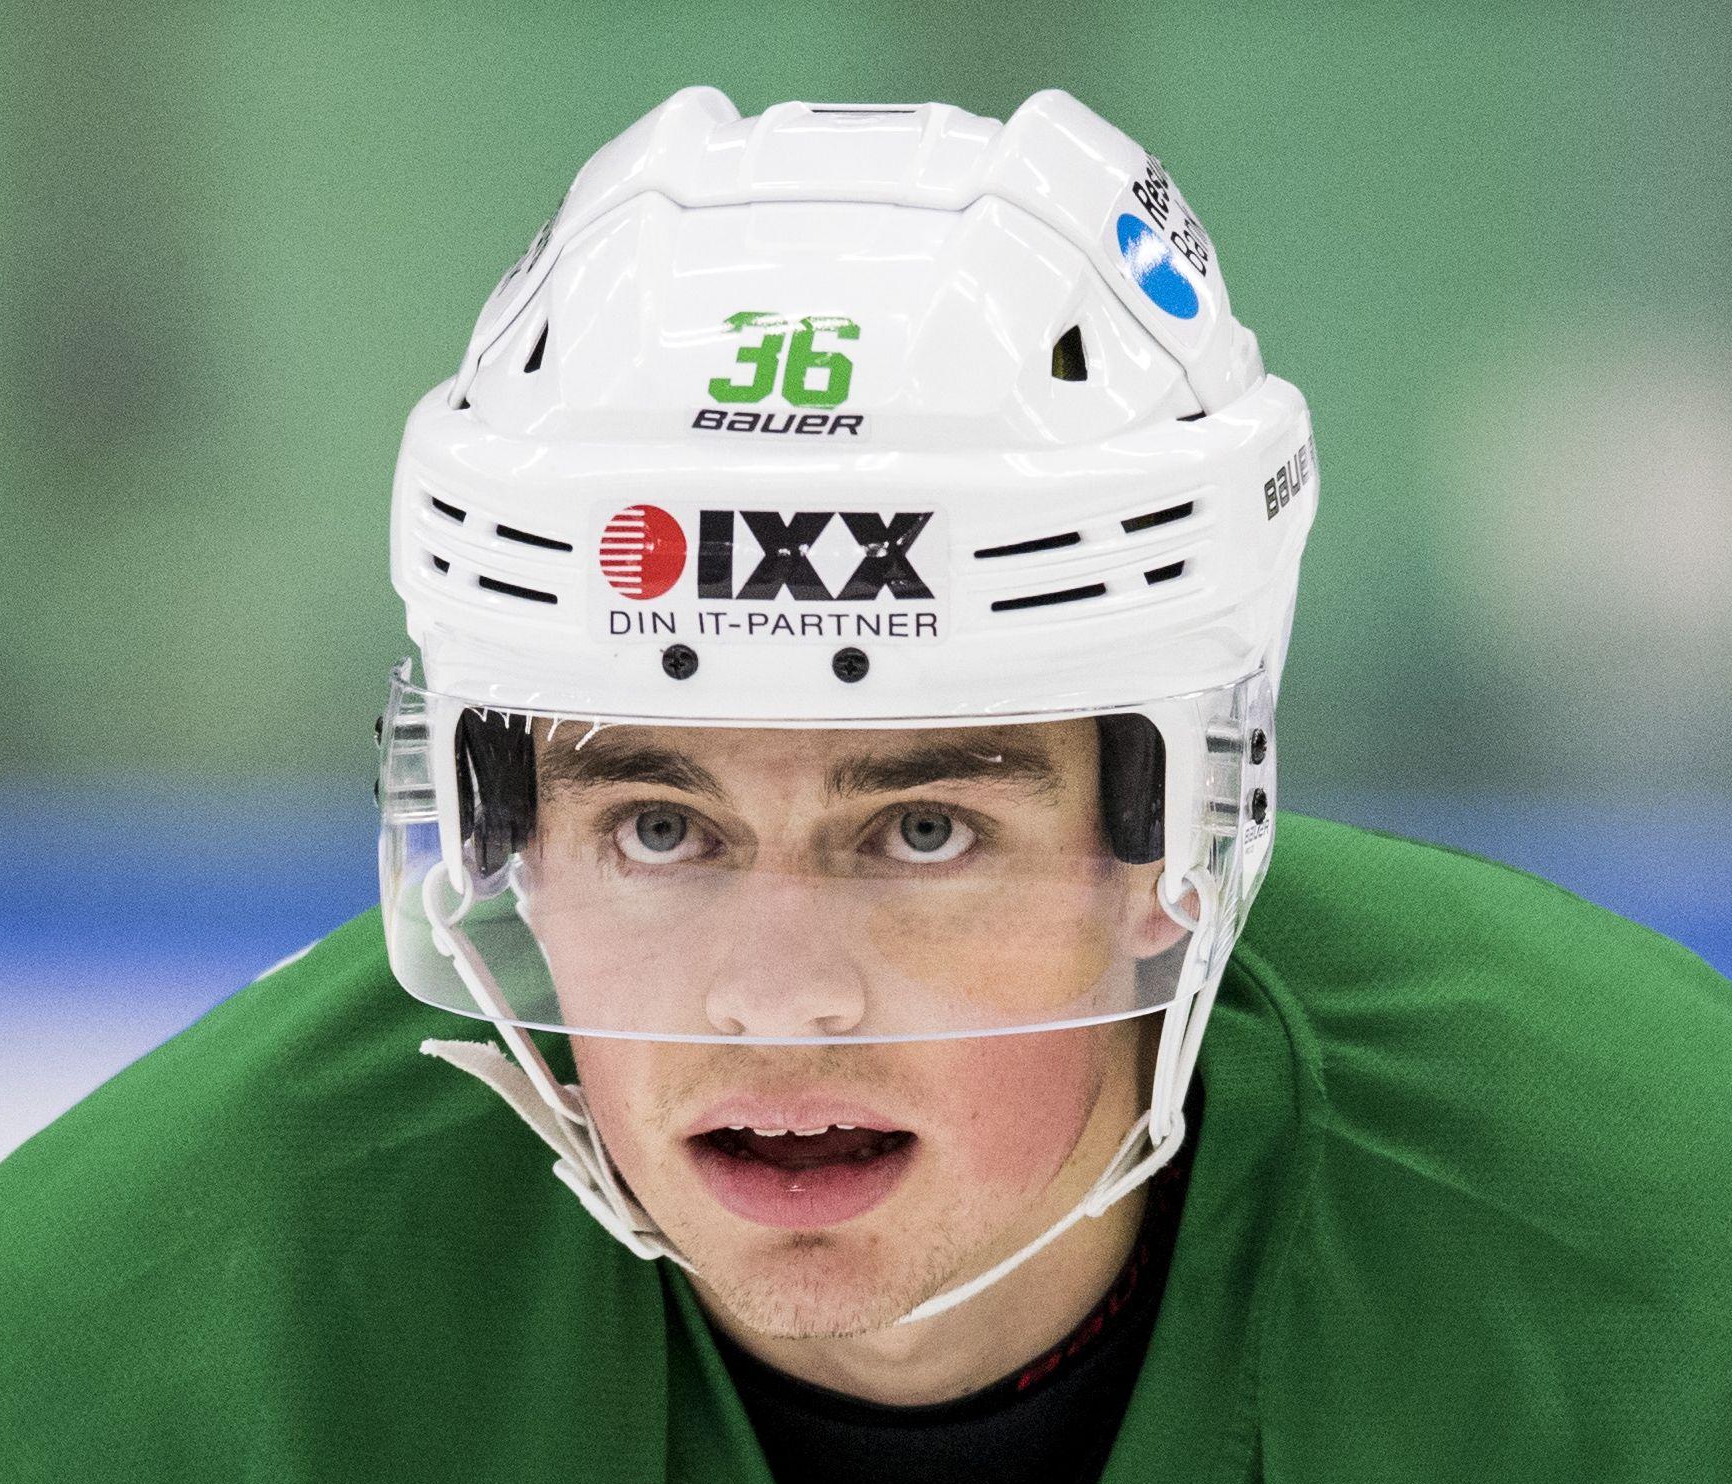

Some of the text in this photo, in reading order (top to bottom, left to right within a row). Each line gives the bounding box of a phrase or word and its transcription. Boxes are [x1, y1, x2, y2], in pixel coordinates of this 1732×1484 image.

[708, 311, 861, 410] 36
[697, 509, 936, 601] IXX
[609, 610, 938, 637] DIN IT-PARTNER
